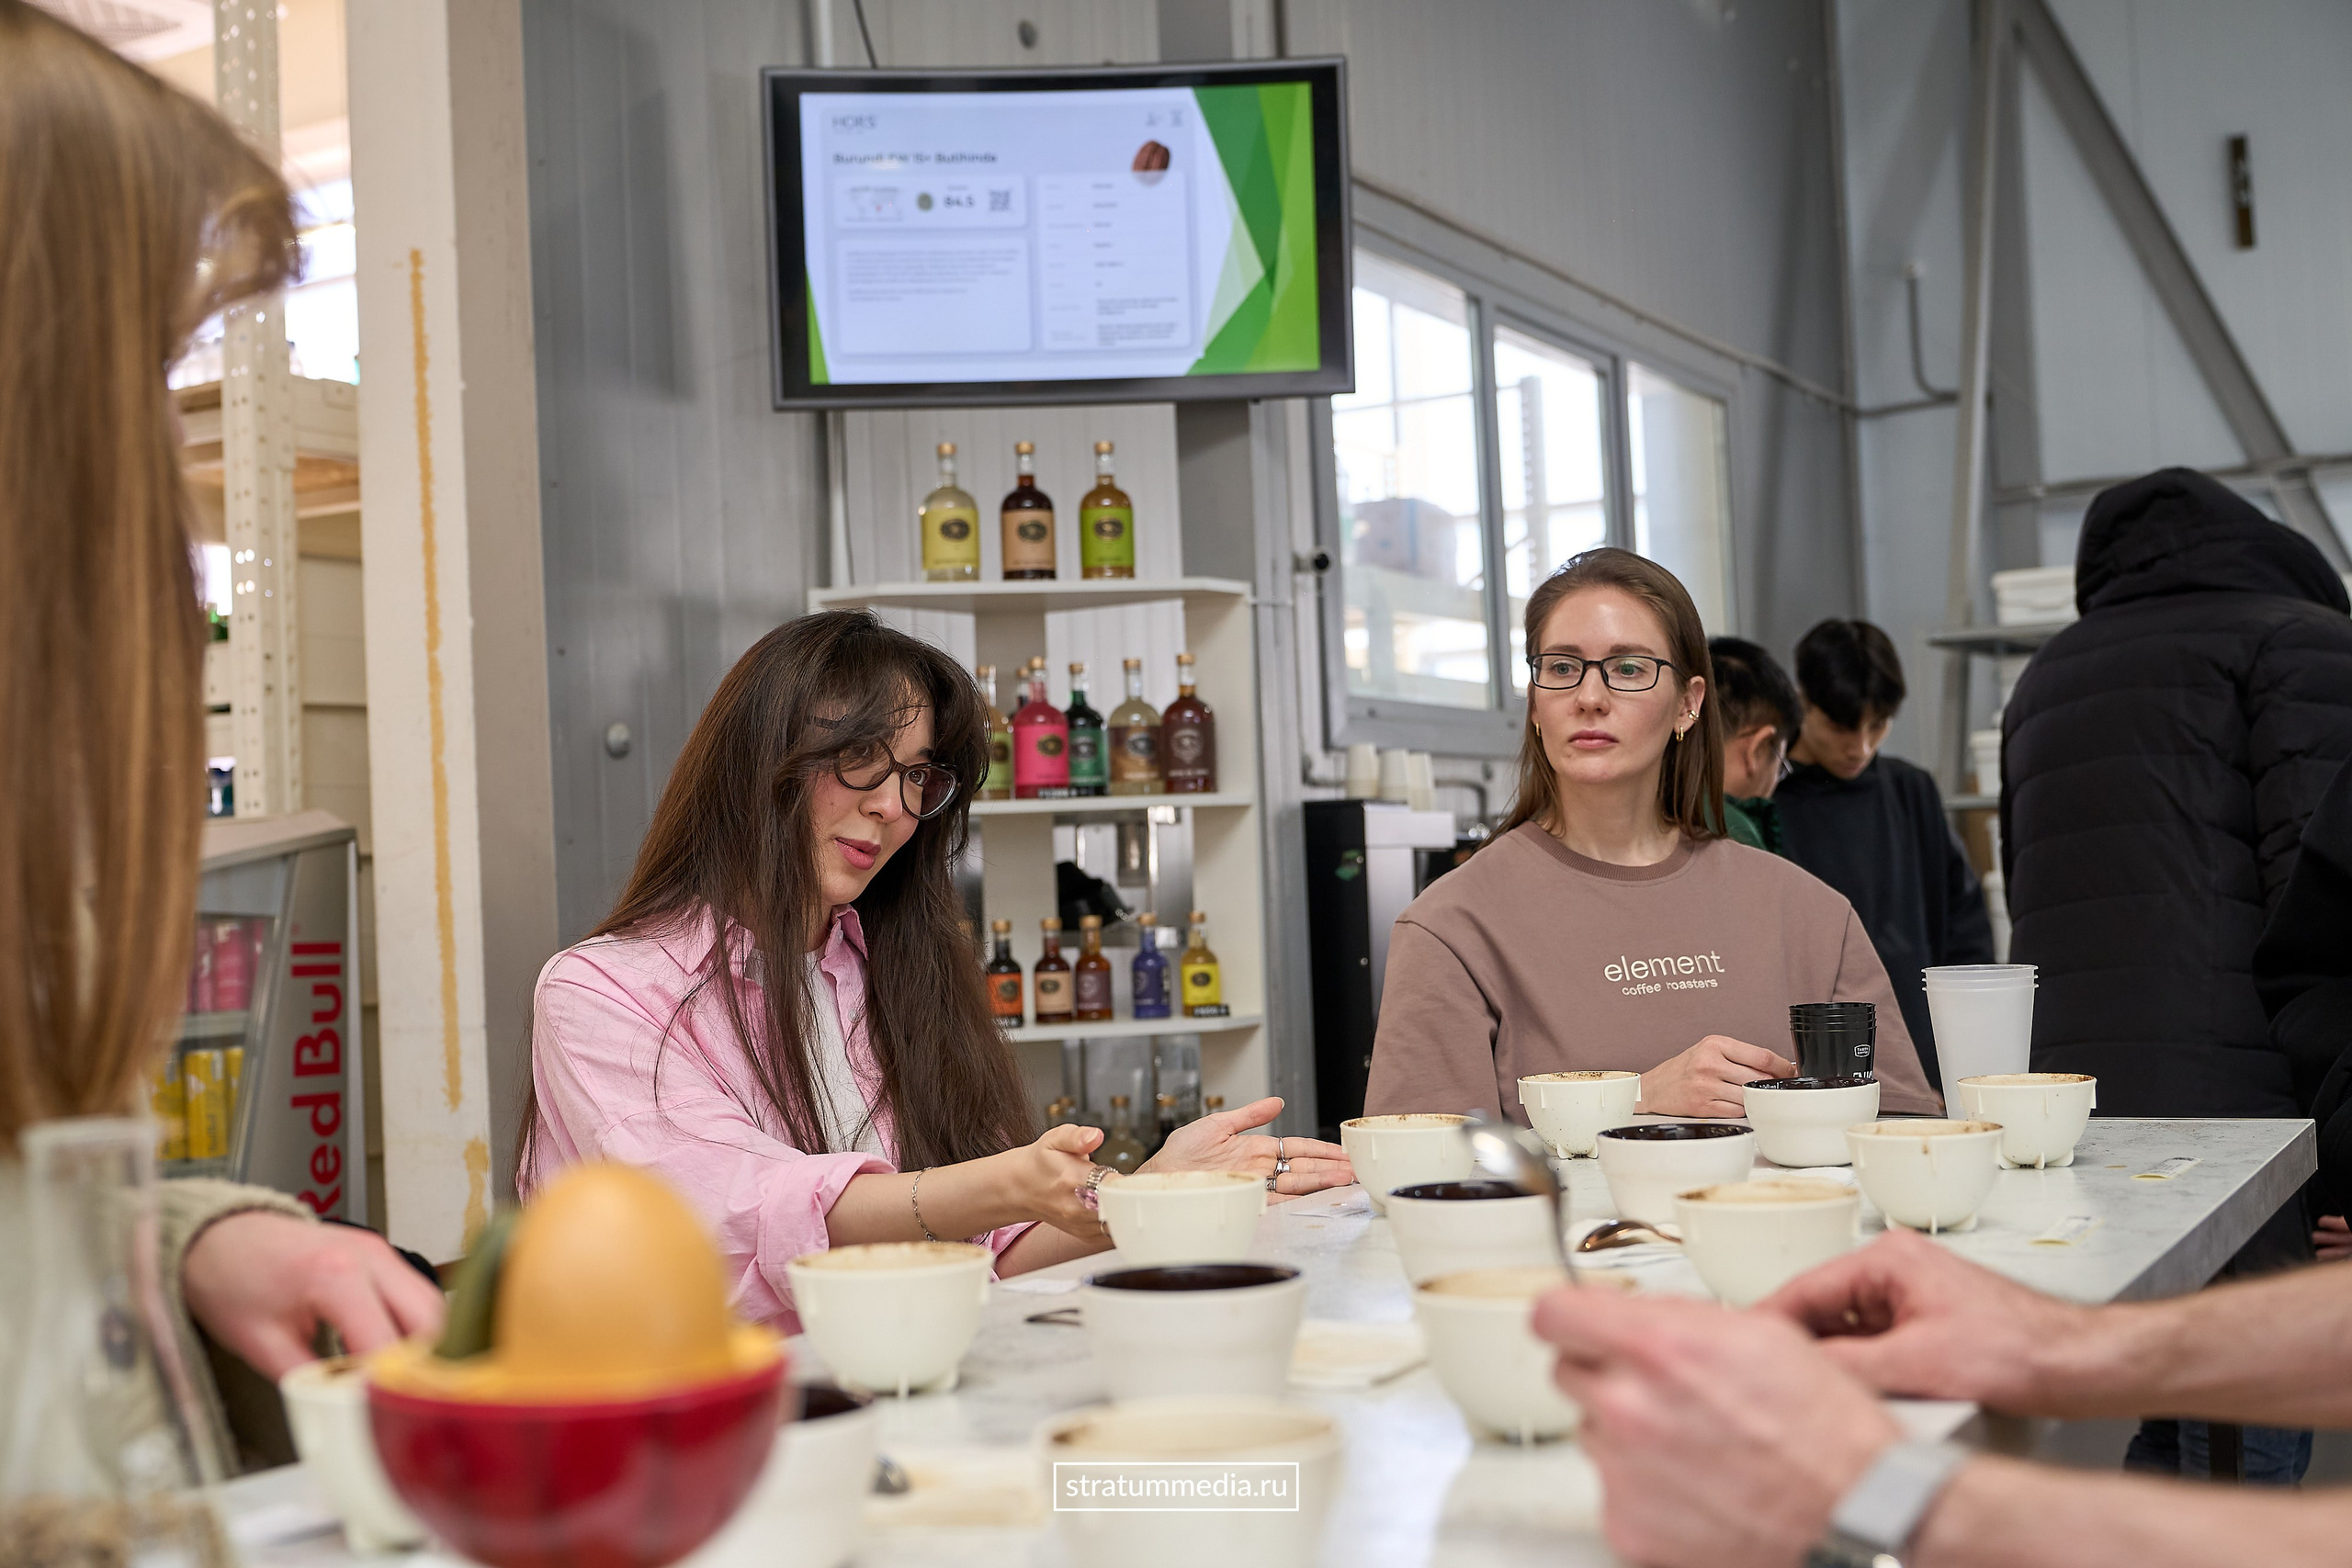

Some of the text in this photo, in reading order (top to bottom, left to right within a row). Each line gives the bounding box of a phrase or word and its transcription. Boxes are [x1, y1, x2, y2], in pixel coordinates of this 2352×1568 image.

[1604, 951, 1725, 982] element
[1622, 978, 1718, 996] coffee roasters
[290, 942, 343, 1078] Bull
